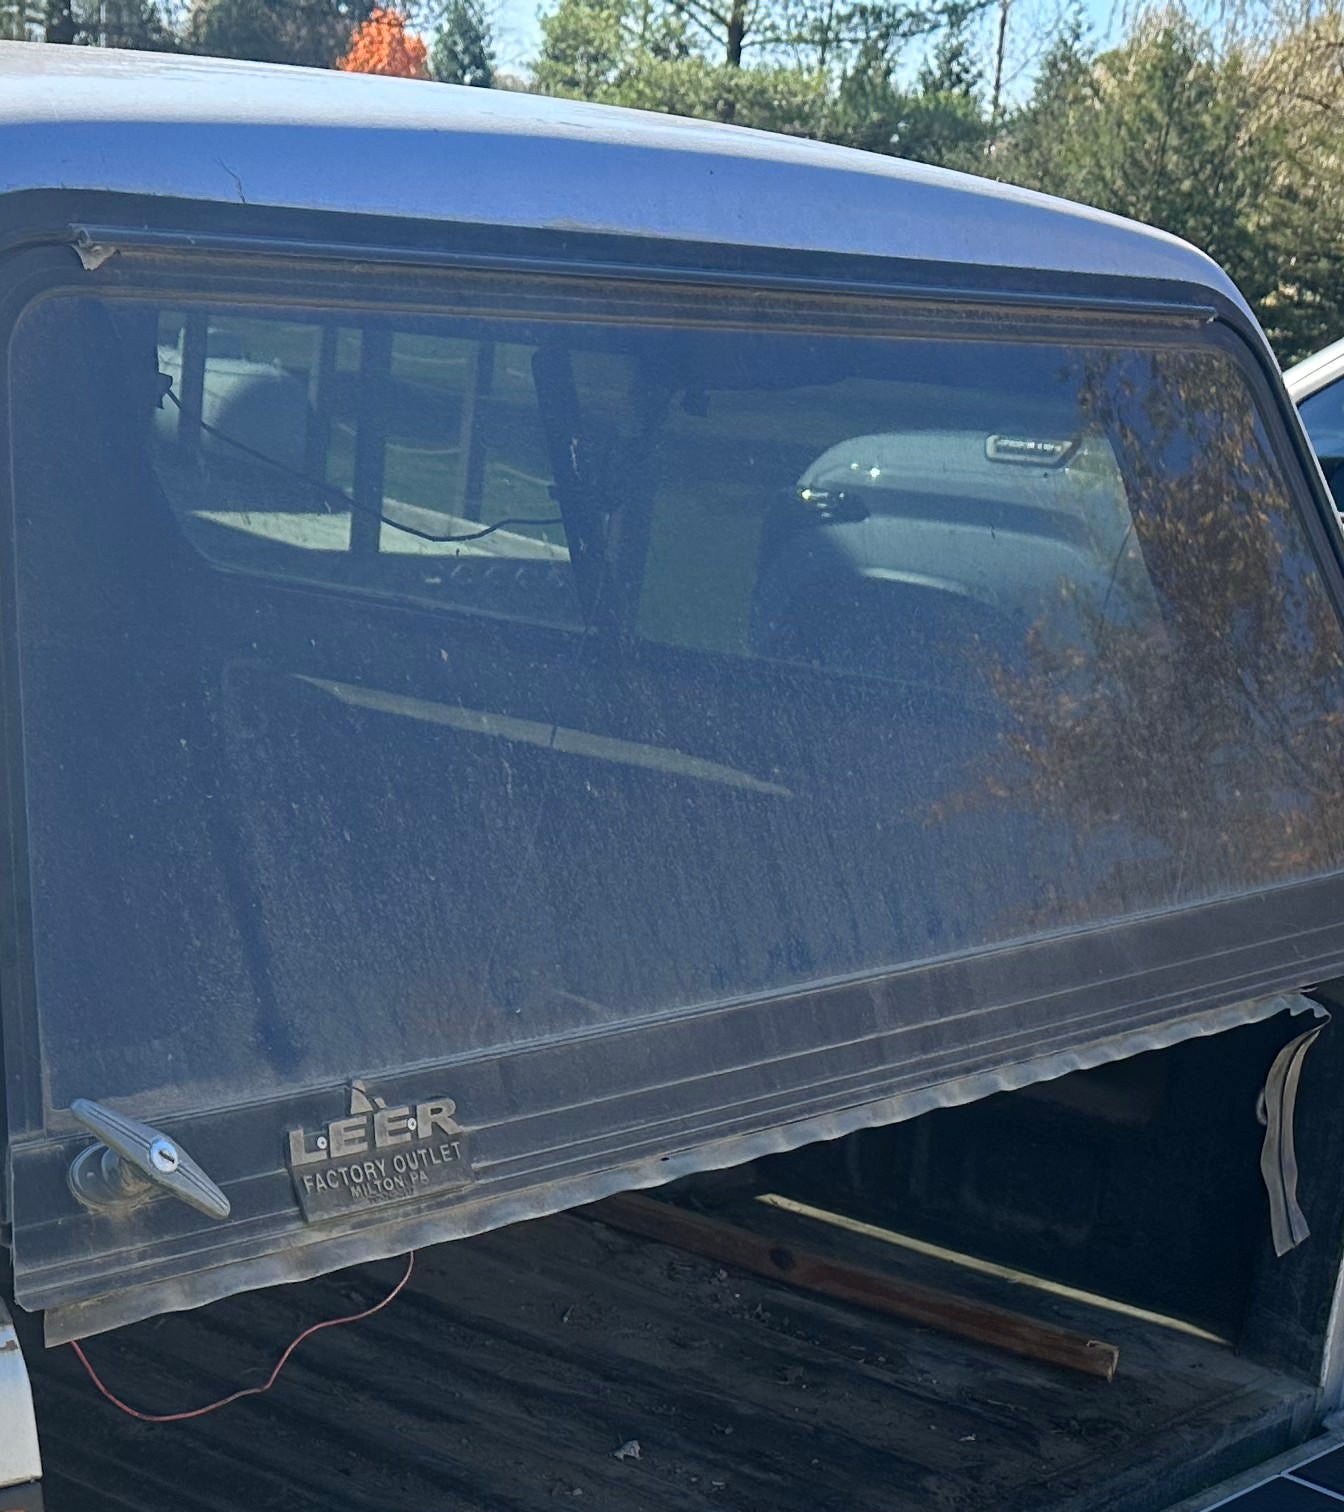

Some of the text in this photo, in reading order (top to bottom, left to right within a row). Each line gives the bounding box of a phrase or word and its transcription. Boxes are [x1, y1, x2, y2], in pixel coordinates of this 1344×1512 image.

[288, 1097, 464, 1166] LEER
[302, 1141, 462, 1194] FACTORY OUTLET
